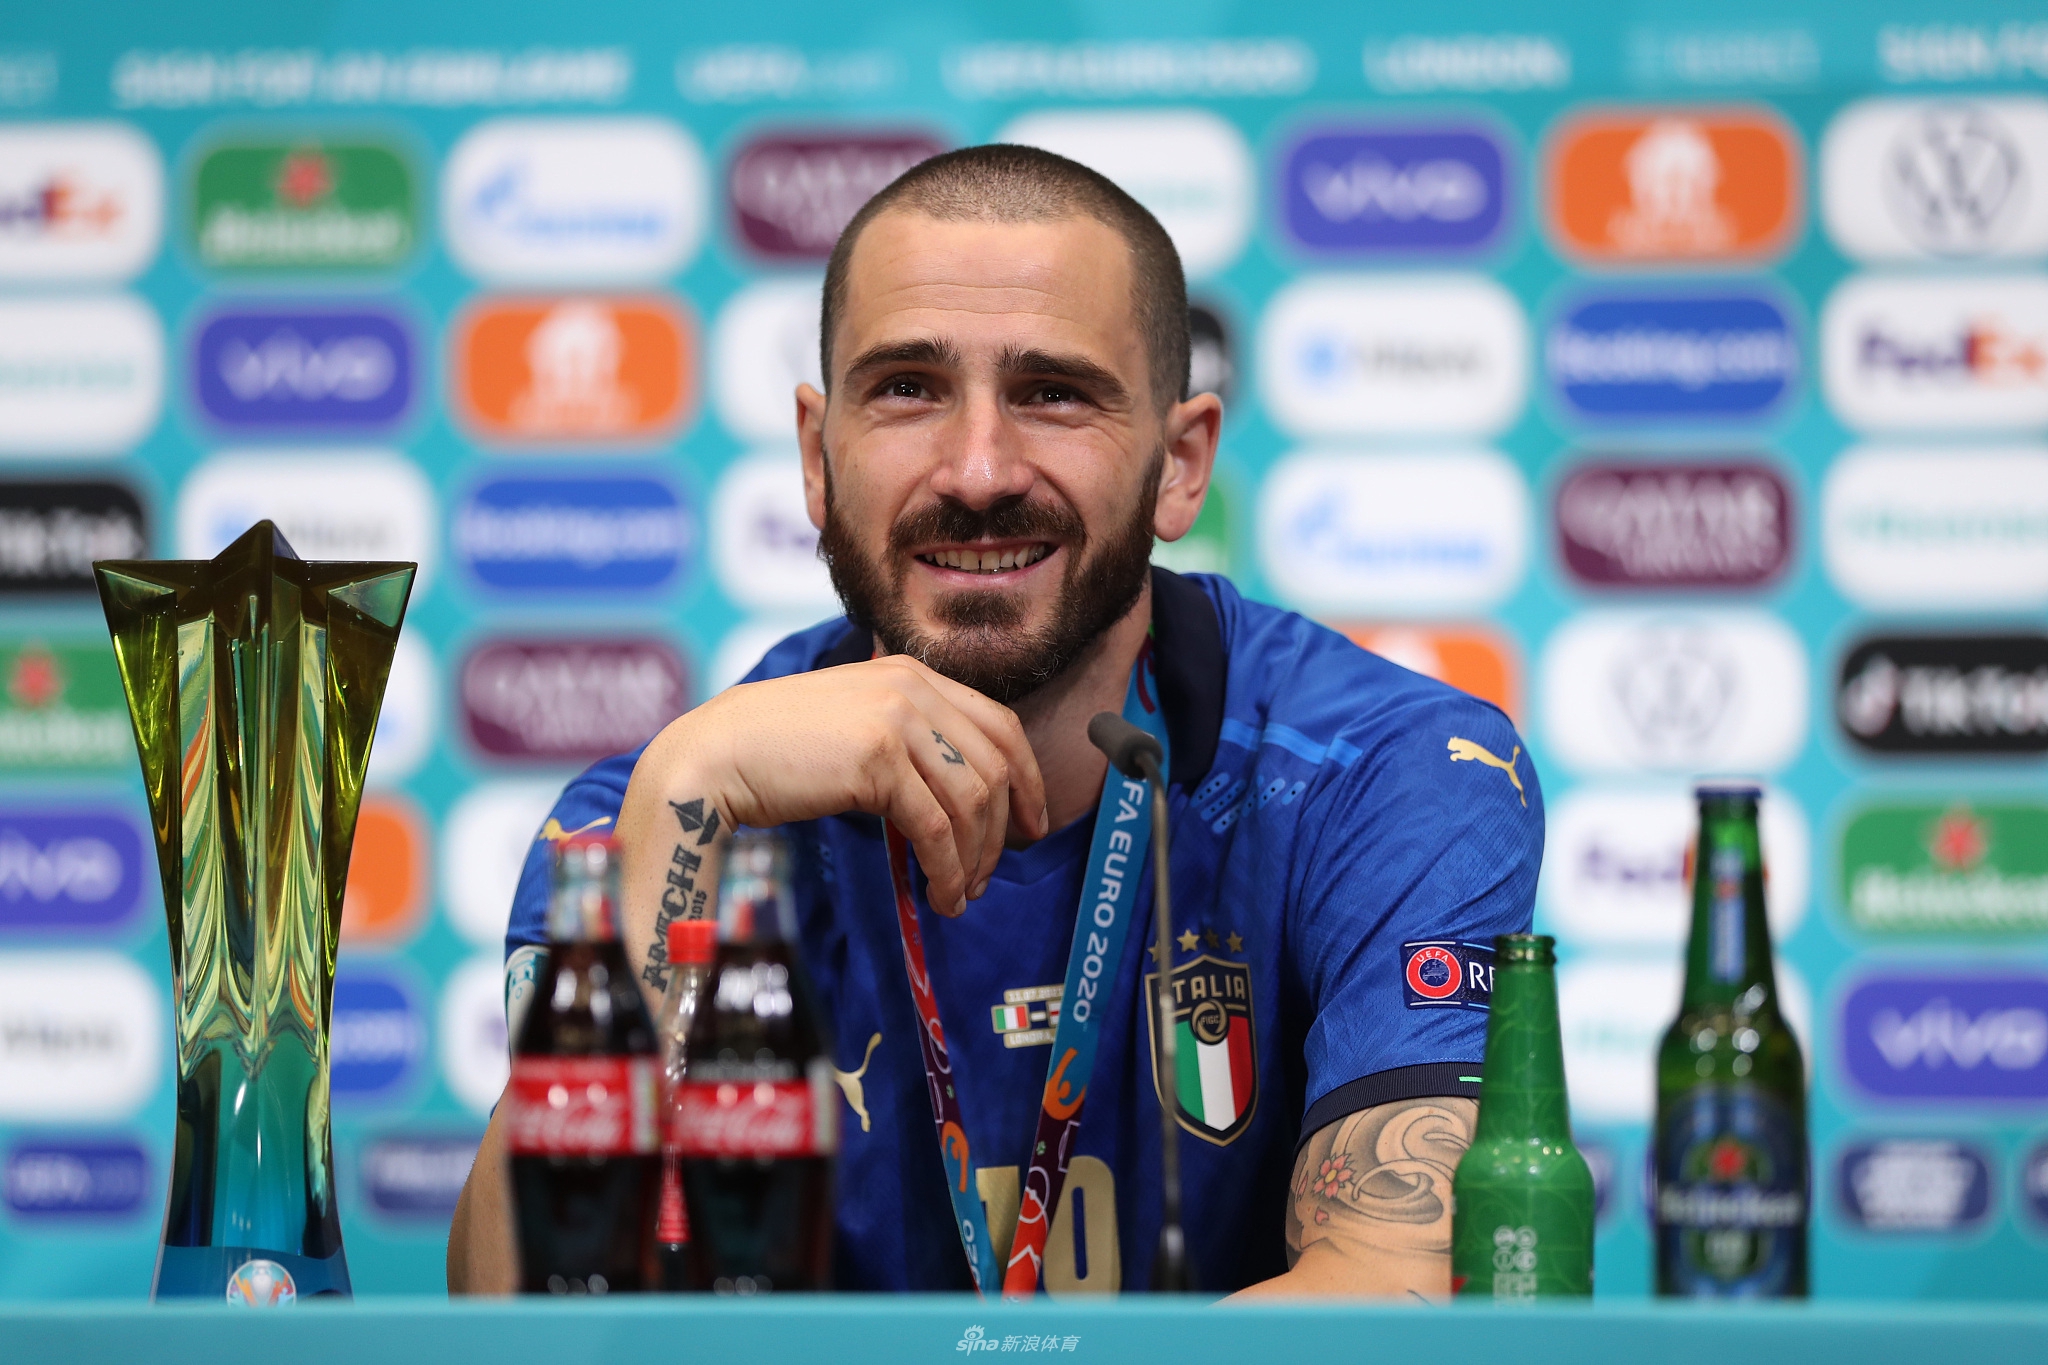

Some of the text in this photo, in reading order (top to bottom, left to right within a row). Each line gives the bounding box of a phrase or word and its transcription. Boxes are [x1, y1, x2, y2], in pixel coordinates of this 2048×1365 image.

[1305, 155, 1488, 221] vivo
[219, 330, 395, 398] vivo
[1093, 829, 1133, 929] EURO
[1073, 931, 1108, 1024] 2020
[1171, 974, 1247, 1004] TALIA
[1416, 950, 1449, 963] UEFA
[1872, 1002, 2047, 1068] vivo
